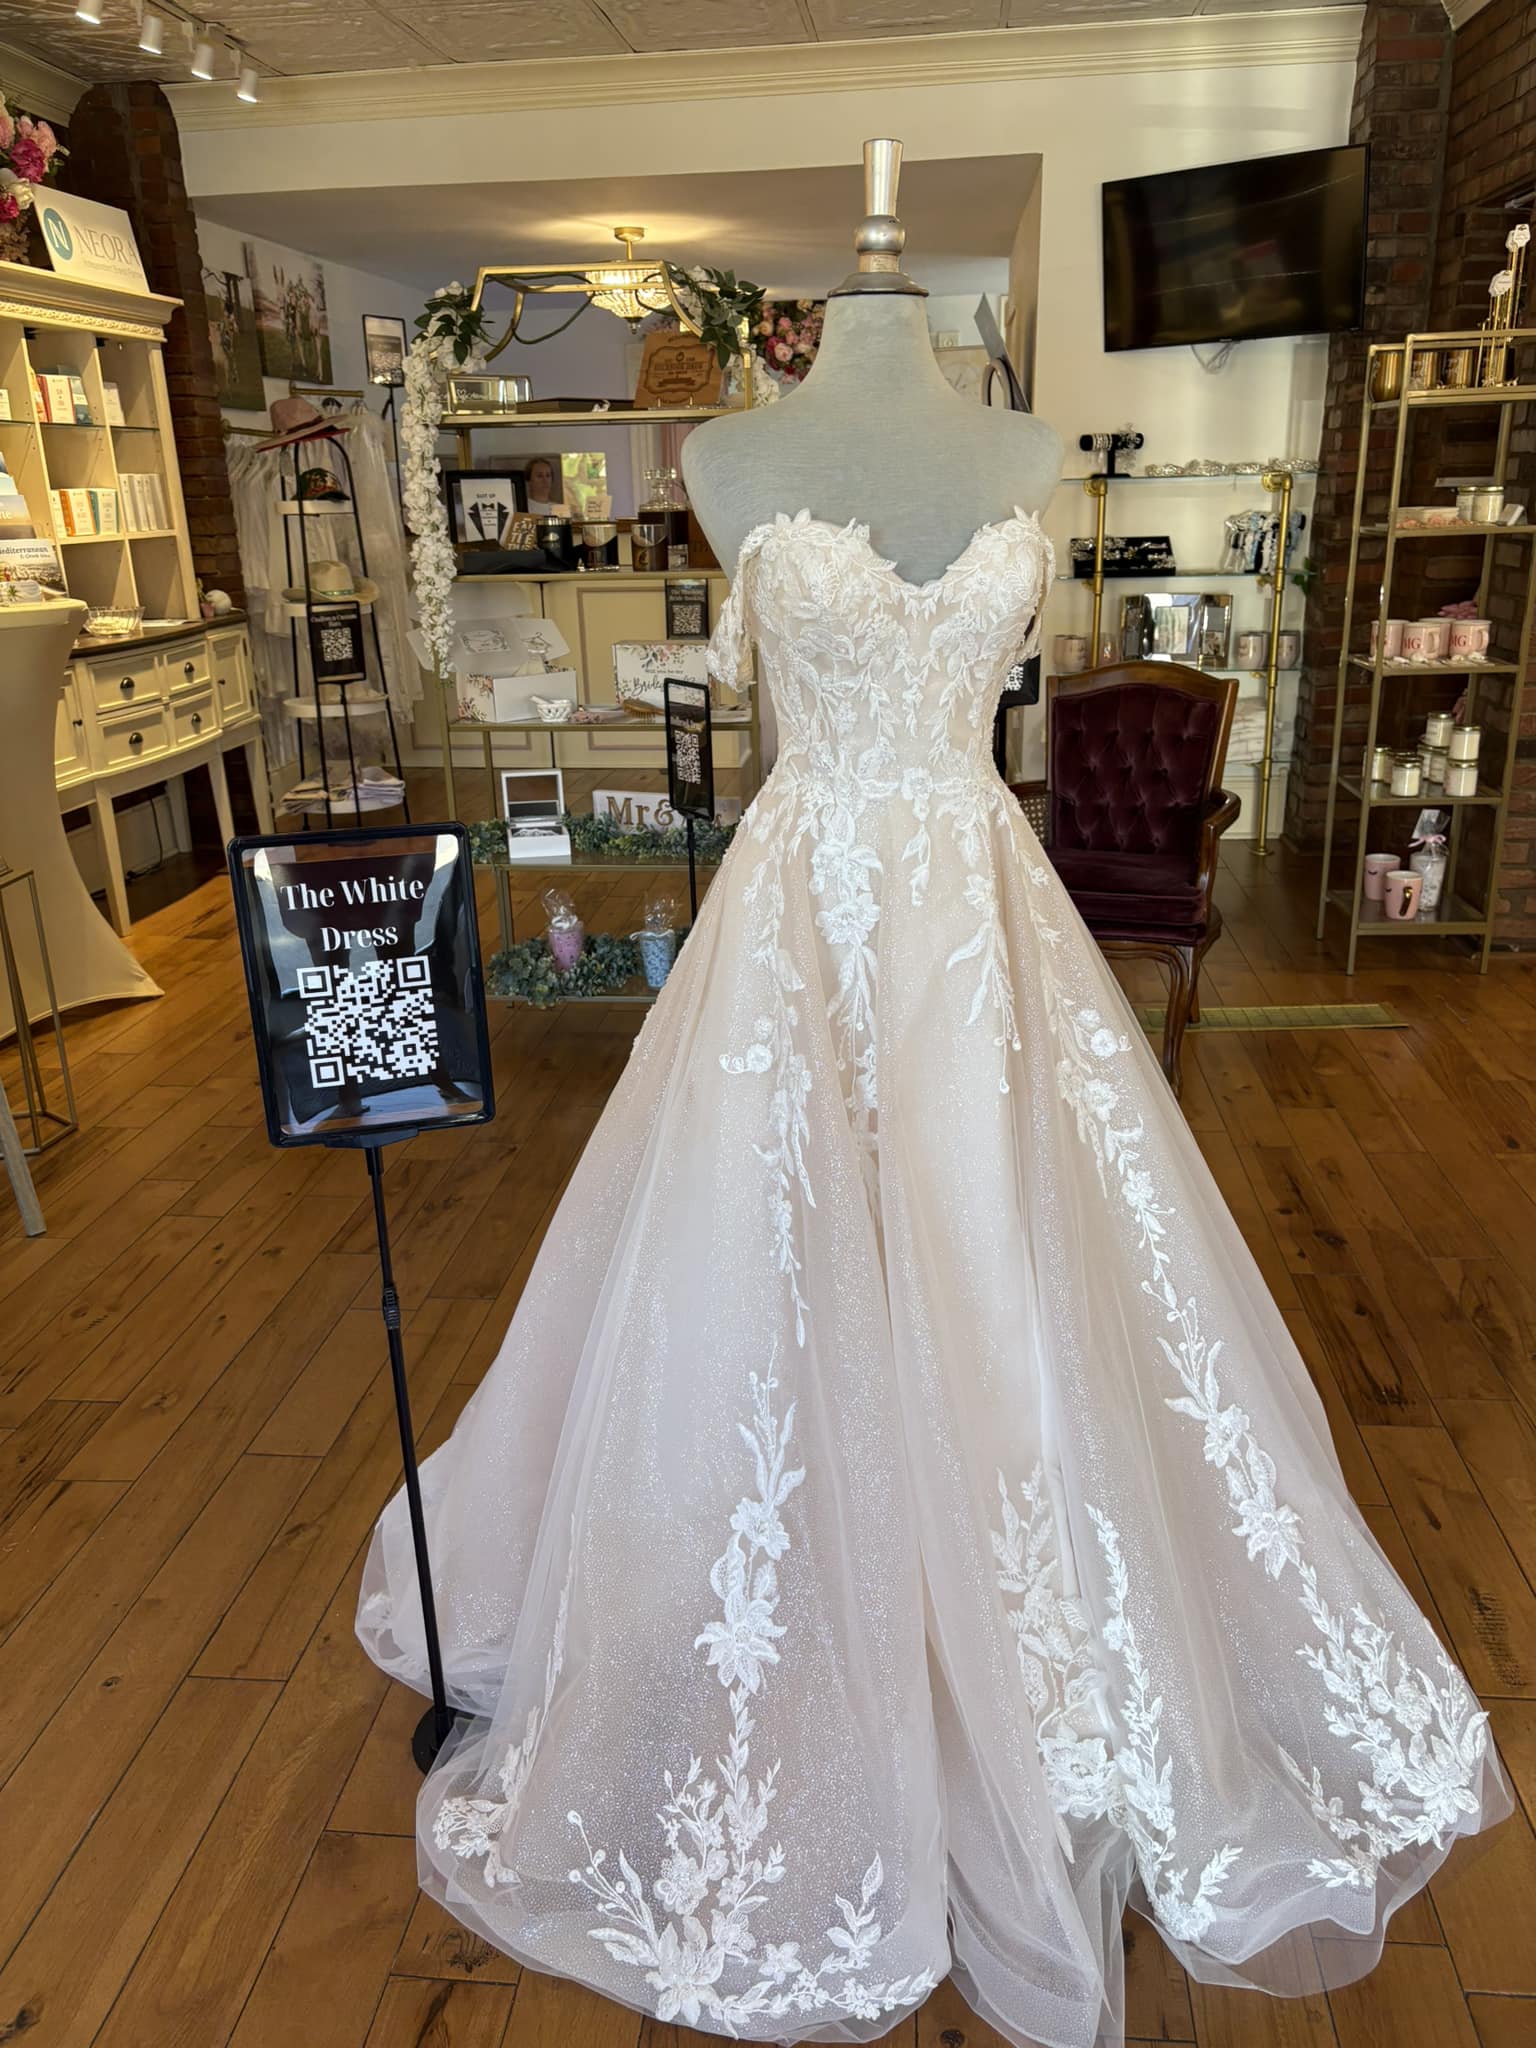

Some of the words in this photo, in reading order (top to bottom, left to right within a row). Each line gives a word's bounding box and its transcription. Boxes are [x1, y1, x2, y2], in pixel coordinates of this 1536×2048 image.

[47, 217, 70, 252] N
[73, 225, 141, 268] NEORA
[0, 545, 49, 554] editerranean
[606, 796, 650, 827] Mr
[653, 799, 675, 827] &
[279, 882, 335, 911] The
[338, 875, 425, 905] White
[319, 926, 399, 952] Dress
